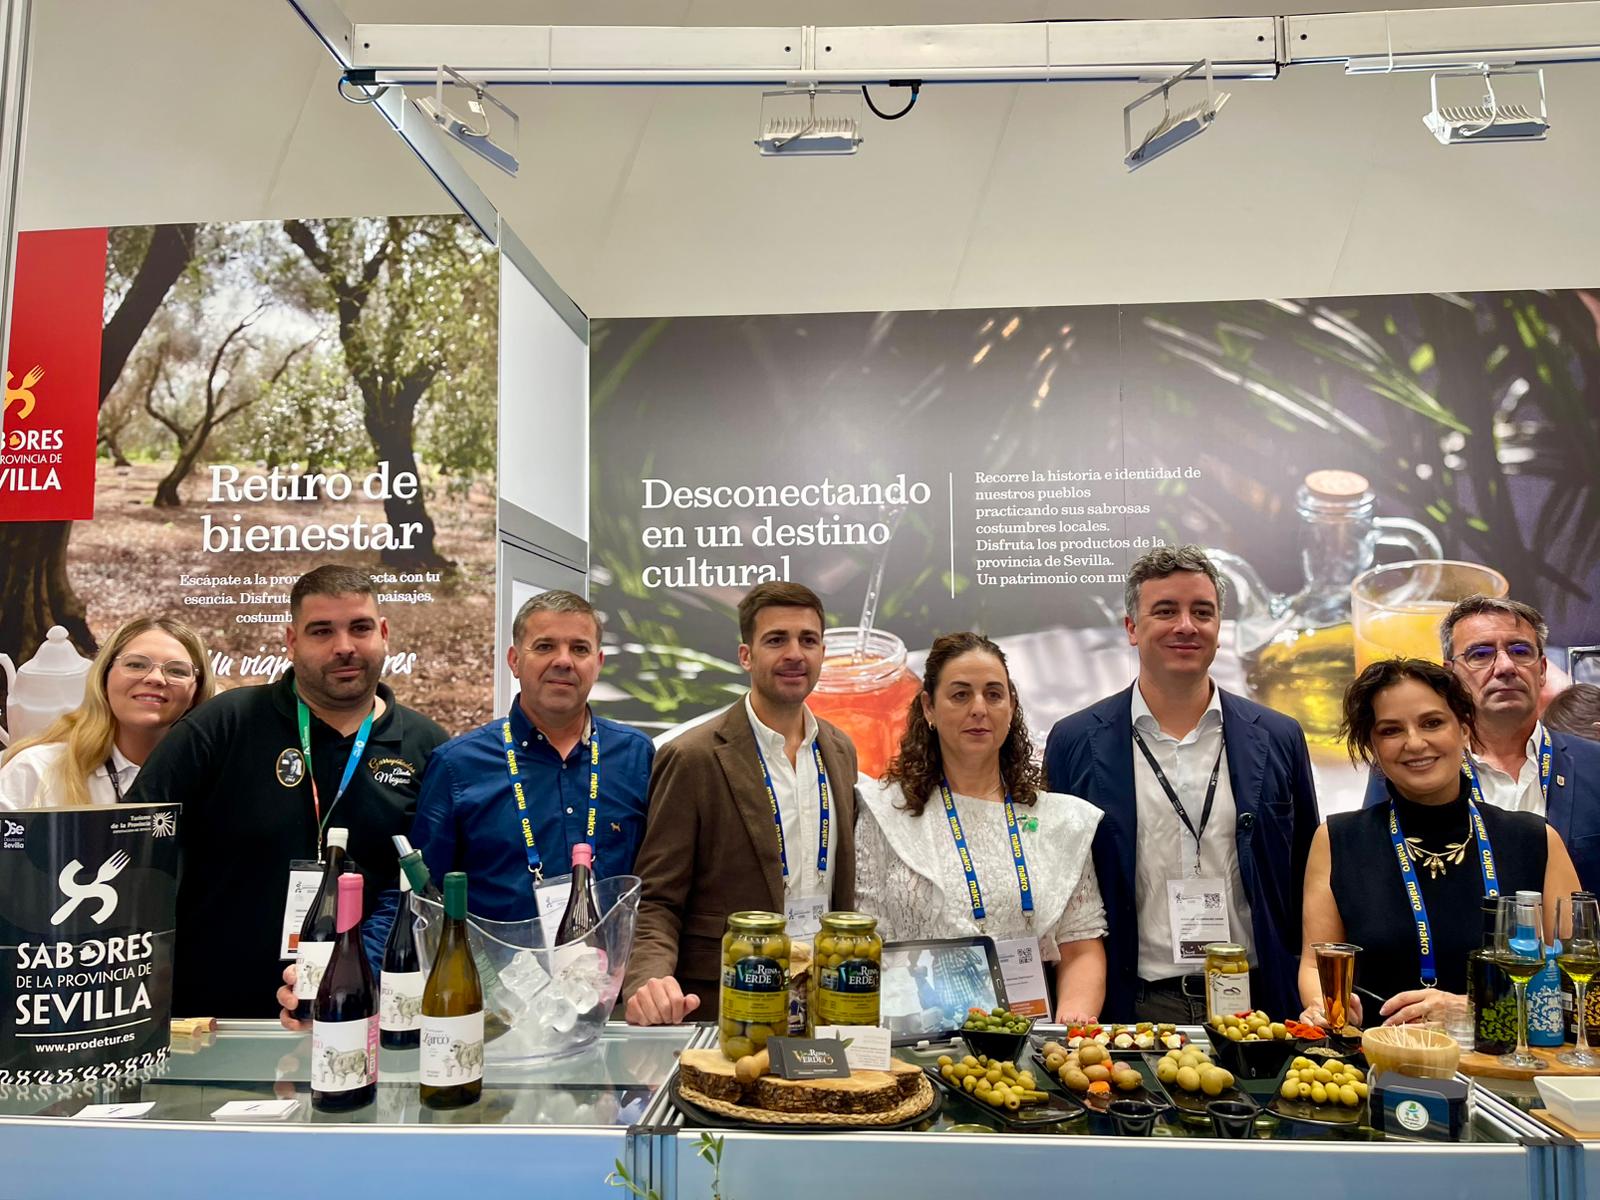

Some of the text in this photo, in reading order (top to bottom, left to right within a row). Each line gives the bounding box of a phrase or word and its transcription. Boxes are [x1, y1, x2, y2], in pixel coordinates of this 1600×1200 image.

[0, 454, 62, 464] ROVINCIA DE
[208, 461, 418, 502] Retiro de
[976, 467, 1200, 483] Recorre la historia e identidad de
[642, 474, 931, 509] Desconectando
[976, 487, 1090, 500] nuestros pueblos
[976, 503, 1150, 519] practicando sus sabrosas
[200, 514, 423, 552] bienestar
[642, 514, 890, 548] en un destino
[976, 521, 1110, 534] costumbres locales.
[976, 536, 1166, 551] Disfruta los productos de la
[642, 555, 790, 588] cultural
[977, 554, 1114, 570] provincia de Sevilla.
[180, 574, 240, 587] Escápate
[243, 576, 252, 584] a
[255, 574, 267, 584] la
[370, 572, 397, 582] ecta
[400, 574, 423, 582] con
[426, 572, 440, 582] tu
[977, 574, 997, 585] Un
[1000, 574, 1077, 587] patrimonio
[1081, 575, 1105, 584] con
[184, 593, 237, 604] esencia.
[378, 590, 434, 604] paisajes,
[236, 611, 293, 623] costumb
[507, 750, 518, 775] makro
[1542, 754, 1550, 777] makro
[514, 782, 526, 810] makro
[590, 773, 598, 799] makro
[942, 787, 952, 810] makro
[587, 808, 596, 836] makro
[1005, 803, 1015, 827] makro
[1389, 809, 1398, 834] makro
[1474, 814, 1487, 841] makro
[522, 818, 534, 847] makro
[950, 816, 962, 840] makro
[1011, 834, 1021, 858] makro
[1396, 843, 1410, 872] makro
[959, 848, 972, 872] makro
[1482, 850, 1495, 879] makro
[1018, 865, 1028, 891] makro
[969, 880, 981, 909] makro
[1407, 881, 1422, 911] makro
[17, 931, 153, 969] SABORES
[1418, 921, 1429, 955] makro
[16, 963, 152, 988] DE LA PROVINCIA DE
[16, 982, 152, 1025] SEVILLA
[36, 1032, 135, 1053] www.prodetur.es
